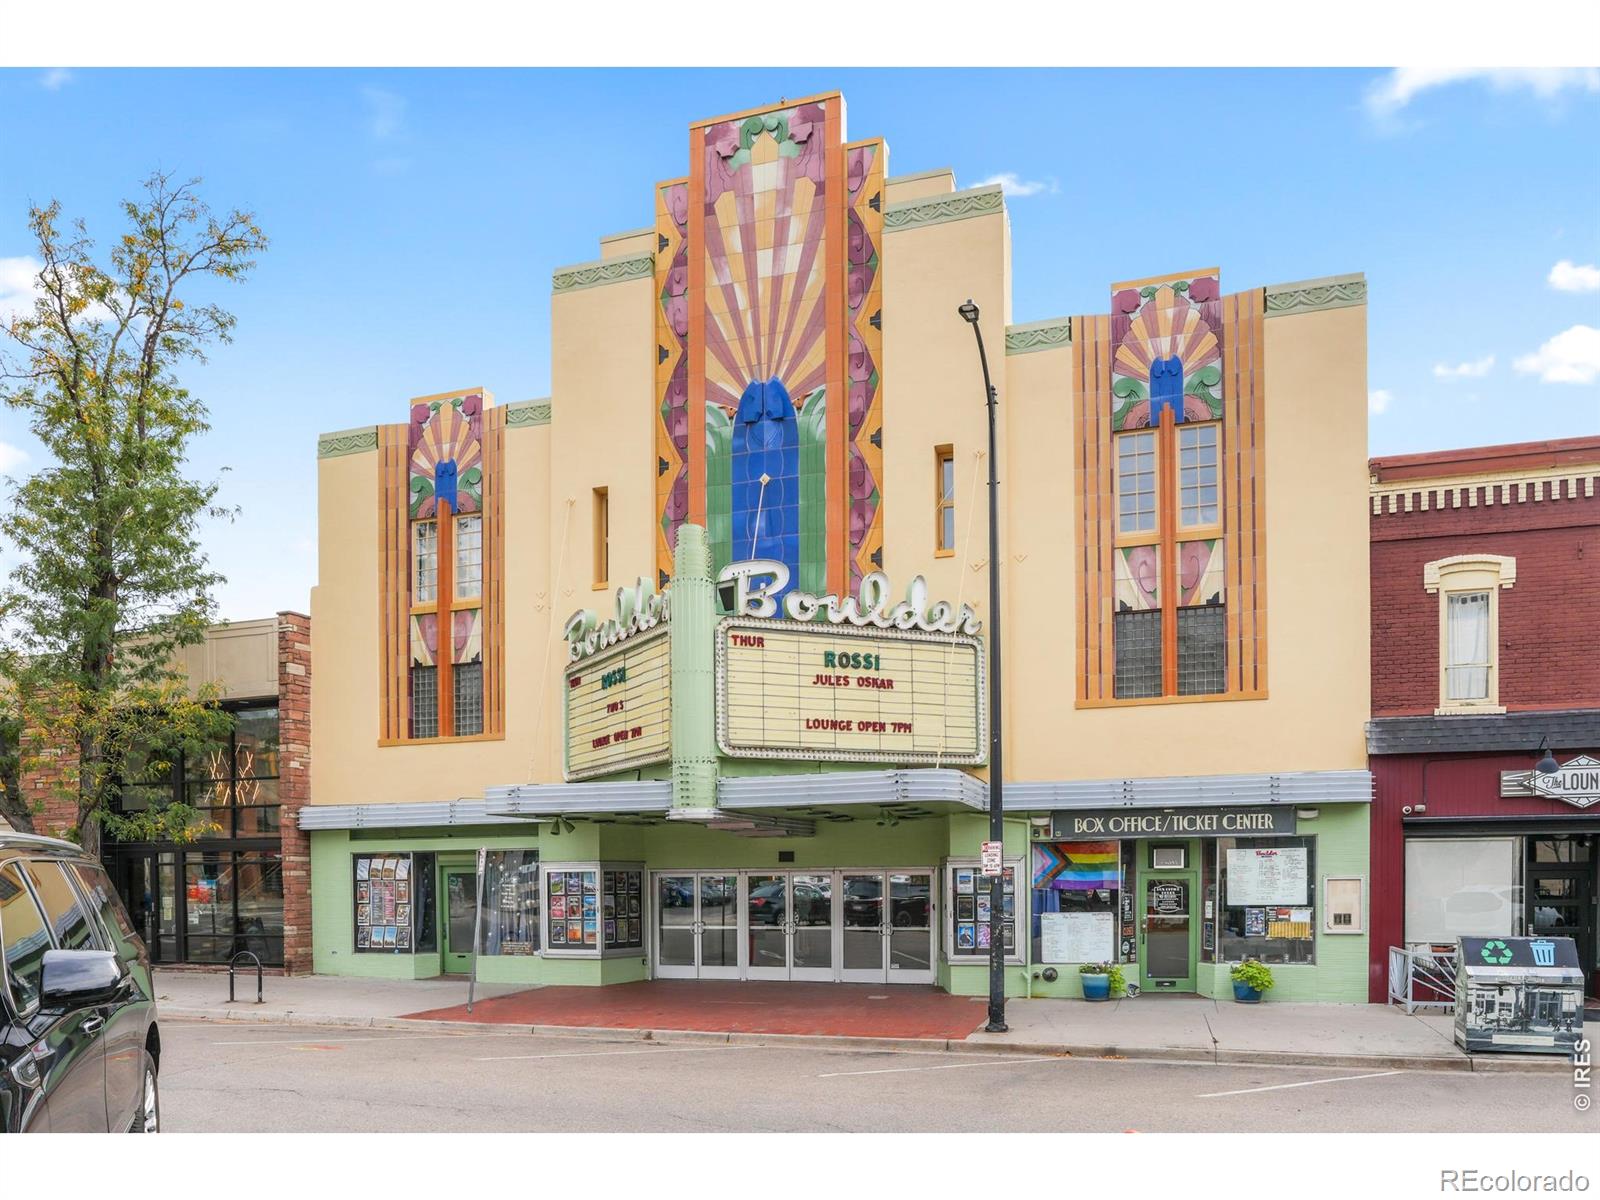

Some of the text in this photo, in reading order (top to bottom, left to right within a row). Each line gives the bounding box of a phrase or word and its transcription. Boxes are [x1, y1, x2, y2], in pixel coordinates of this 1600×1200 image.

[717, 559, 982, 635] Boulder
[731, 634, 765, 648] THUR
[824, 650, 881, 671] ROSSI
[812, 674, 894, 690] JULES OSKAR
[806, 718, 912, 734] LOUNGE OPEN 7PM
[1542, 775, 1562, 789] The
[1074, 813, 1274, 833] BOX OFFICE/TICKET CENTER
